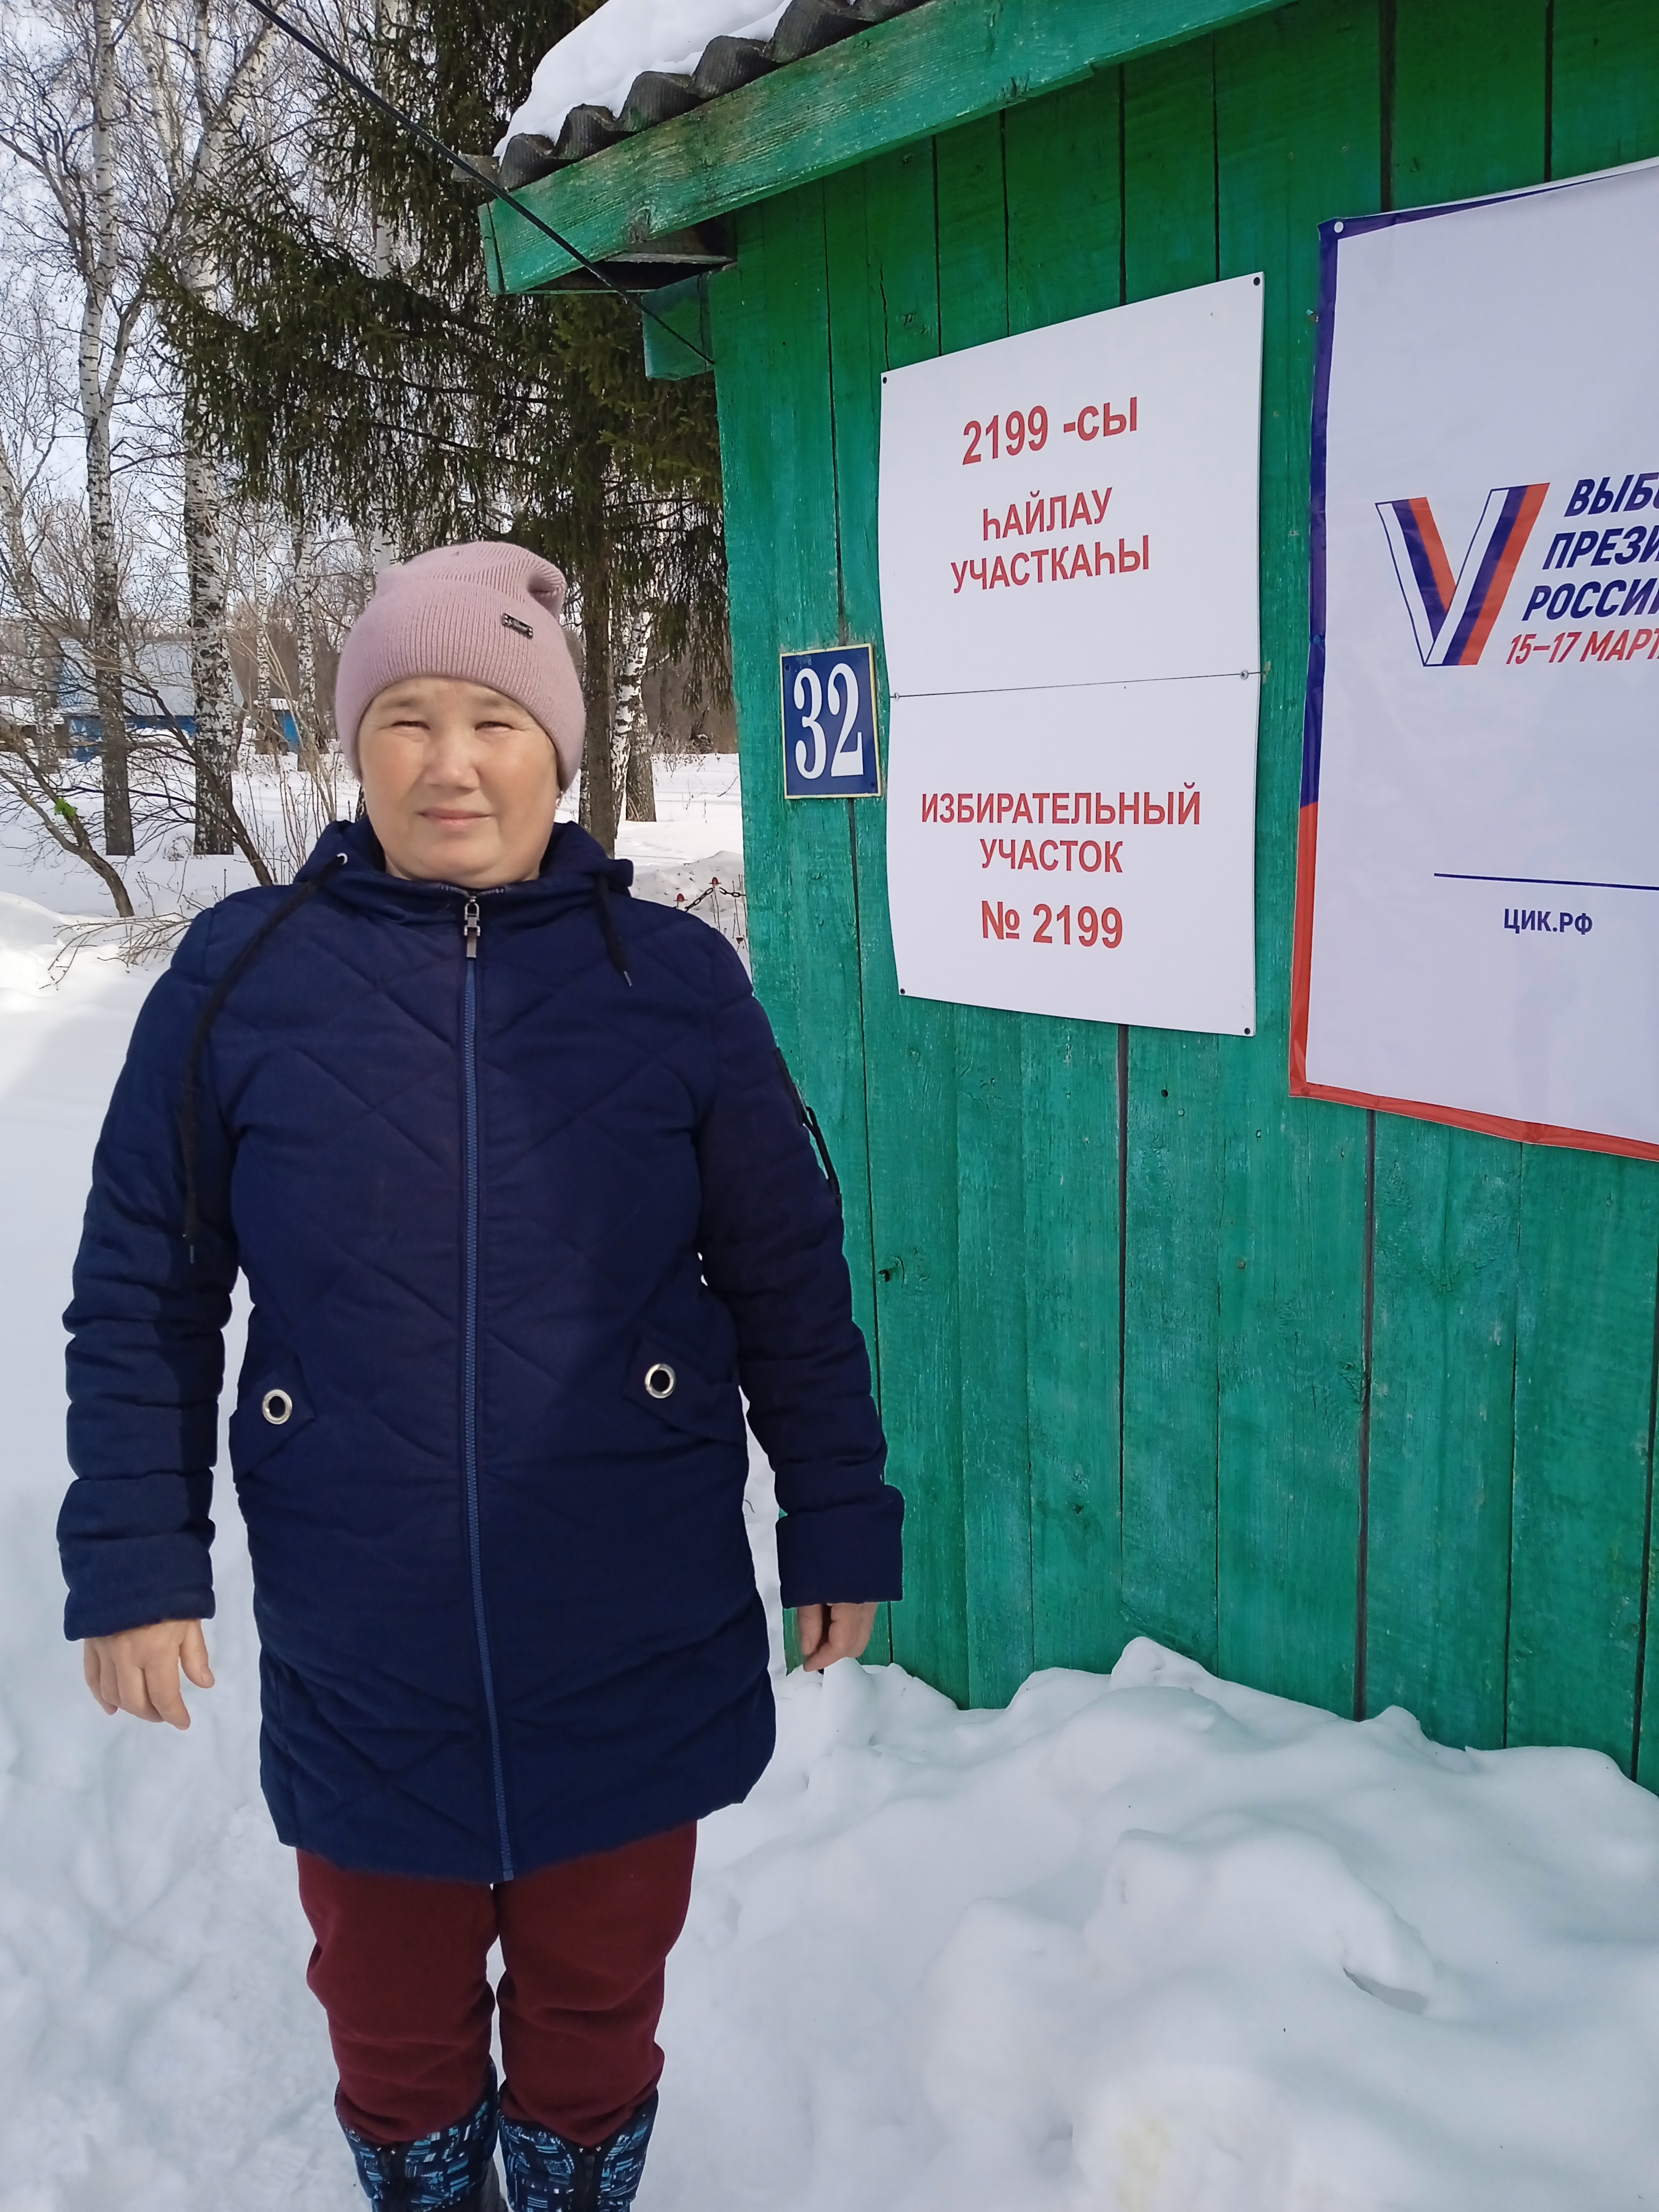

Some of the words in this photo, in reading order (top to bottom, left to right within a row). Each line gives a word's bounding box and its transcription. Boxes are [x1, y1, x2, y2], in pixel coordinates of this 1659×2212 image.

[962, 405, 1048, 465] 2199
[1521, 578, 1659, 622] РОССИ
[1580, 628, 1659, 662] МАРТ
[794, 663, 864, 779] 32
[921, 782, 1200, 825] ИЗБИРАТЕЛЬНЫЙ
[980, 839, 1124, 873] УЧАСТОК
[982, 900, 1020, 940] №
[1033, 903, 1123, 949] 2199
[1504, 908, 1593, 935] ЦИК.РФ
